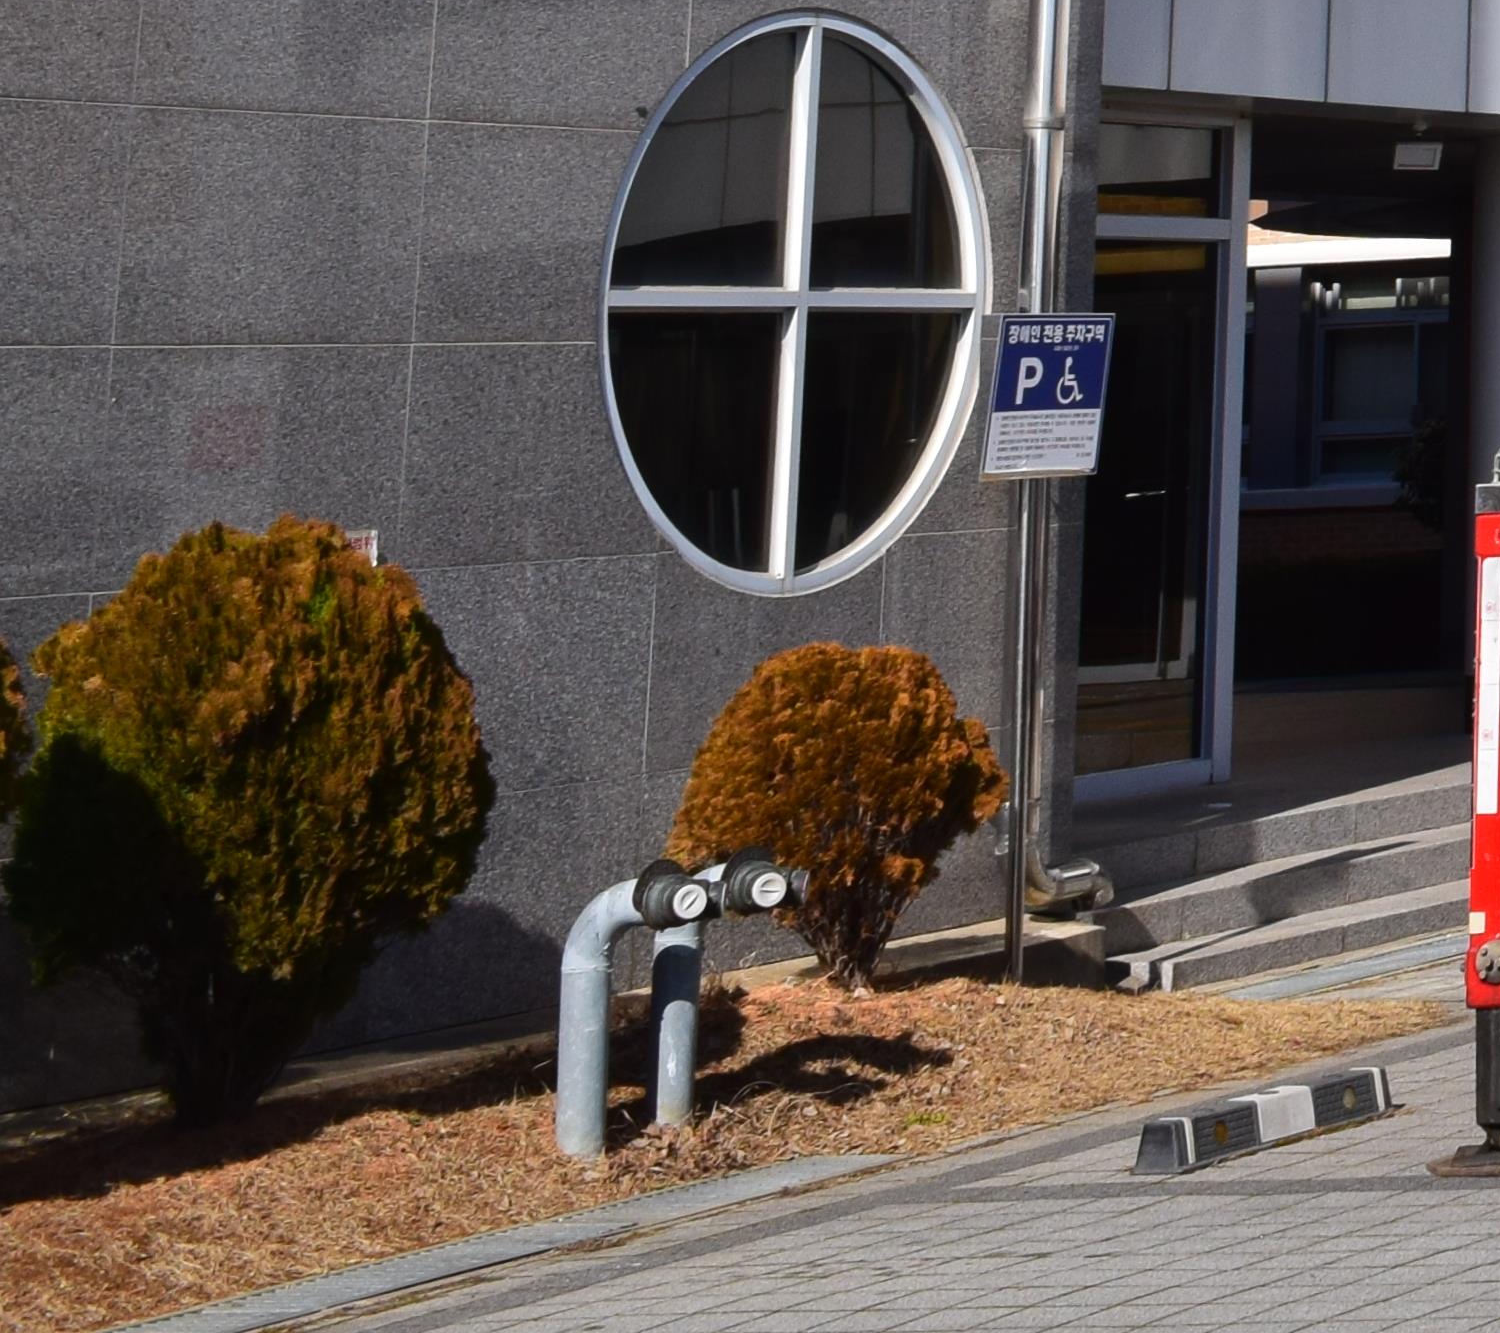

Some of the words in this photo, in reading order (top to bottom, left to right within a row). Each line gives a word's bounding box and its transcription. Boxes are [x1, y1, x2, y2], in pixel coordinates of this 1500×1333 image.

[1008, 324, 1041, 344] 장애인
[1042, 324, 1064, 343] 전용
[1065, 324, 1106, 343] 주차구역
[1015, 356, 1044, 405] P
